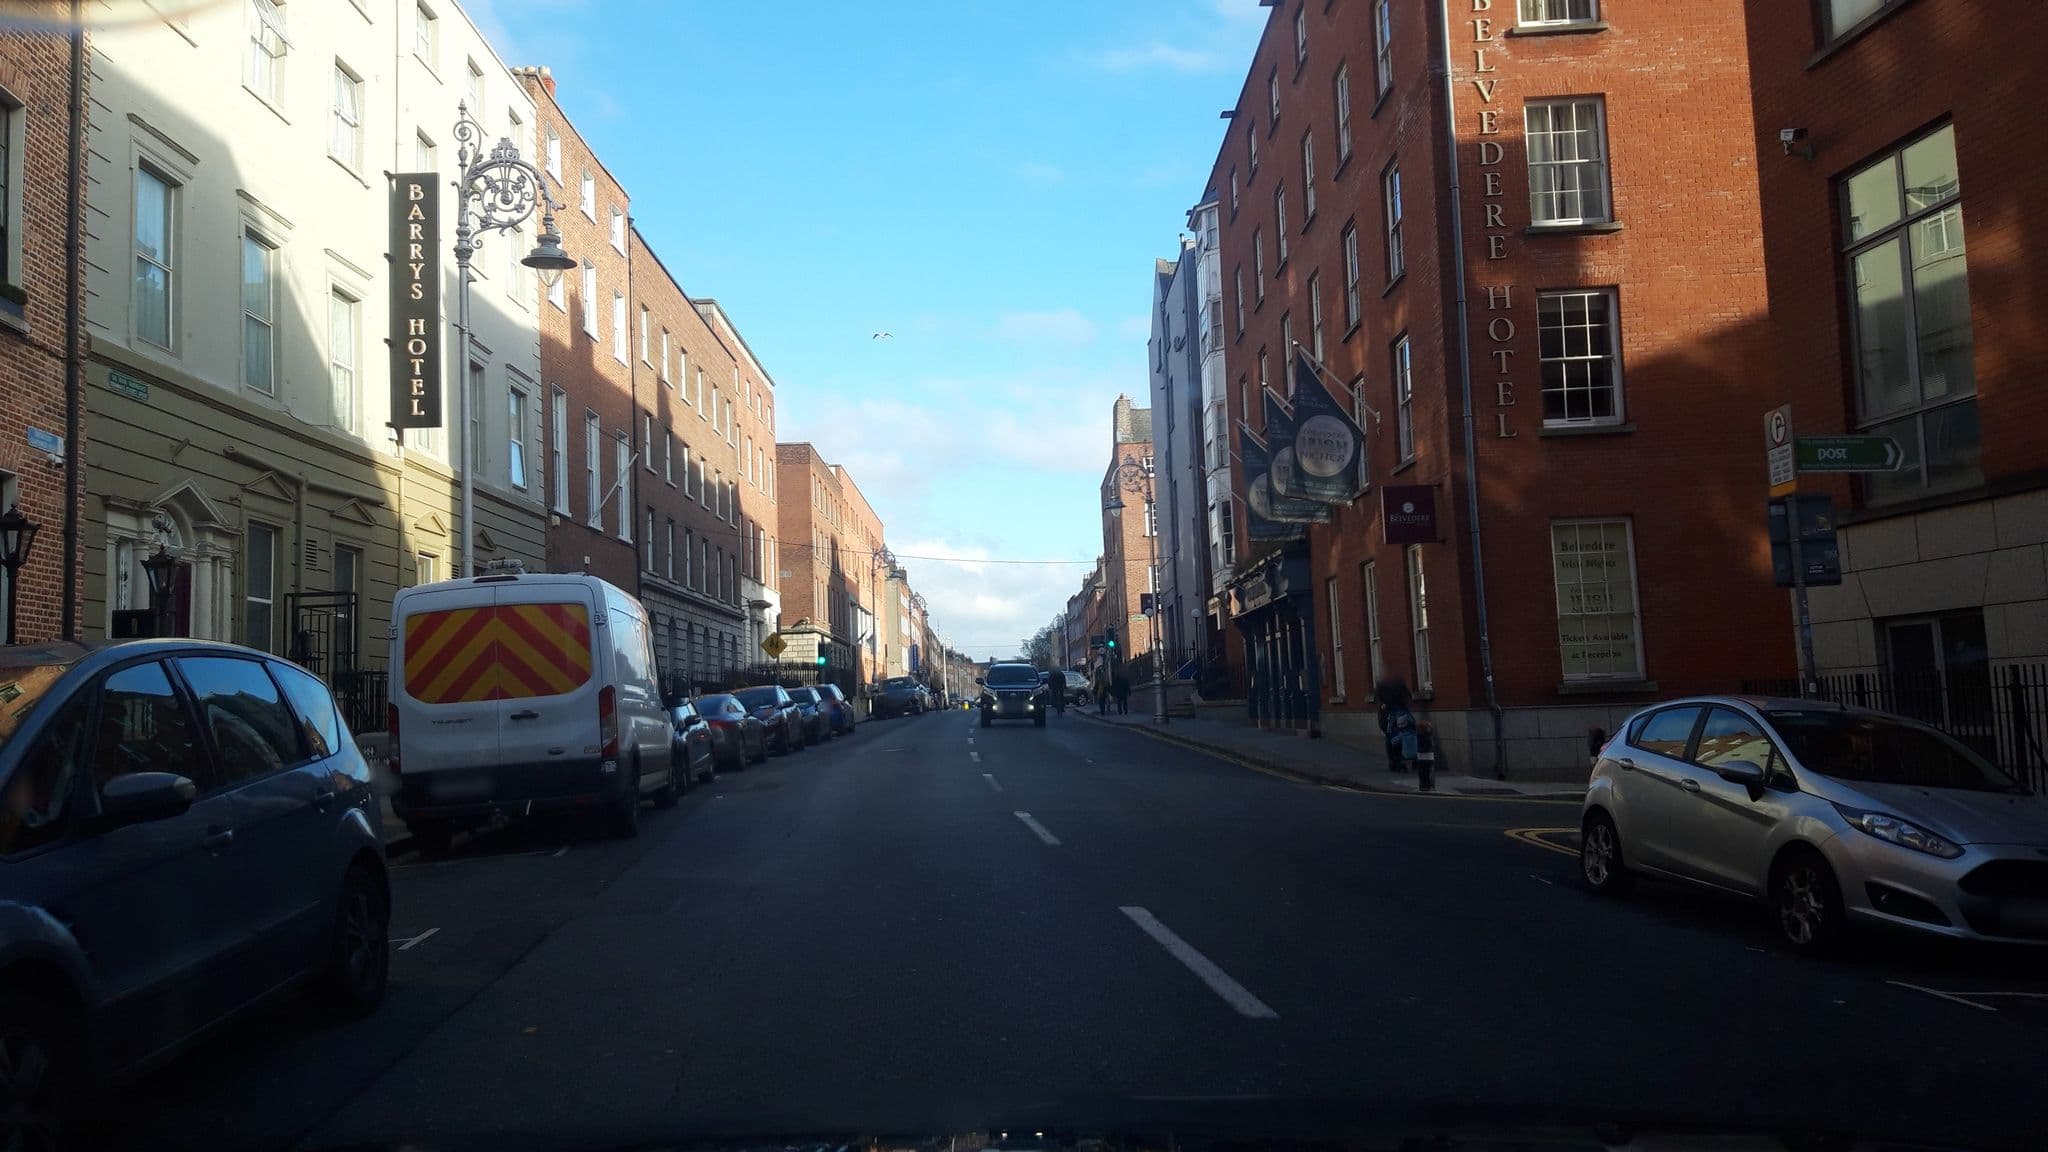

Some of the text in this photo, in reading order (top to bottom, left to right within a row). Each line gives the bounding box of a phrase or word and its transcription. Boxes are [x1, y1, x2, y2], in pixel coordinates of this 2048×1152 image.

[408, 183, 427, 416] BARRYS HOTEL
[1486, 285, 1517, 438] HOTEL
[1560, 540, 1617, 552] Belvedere
